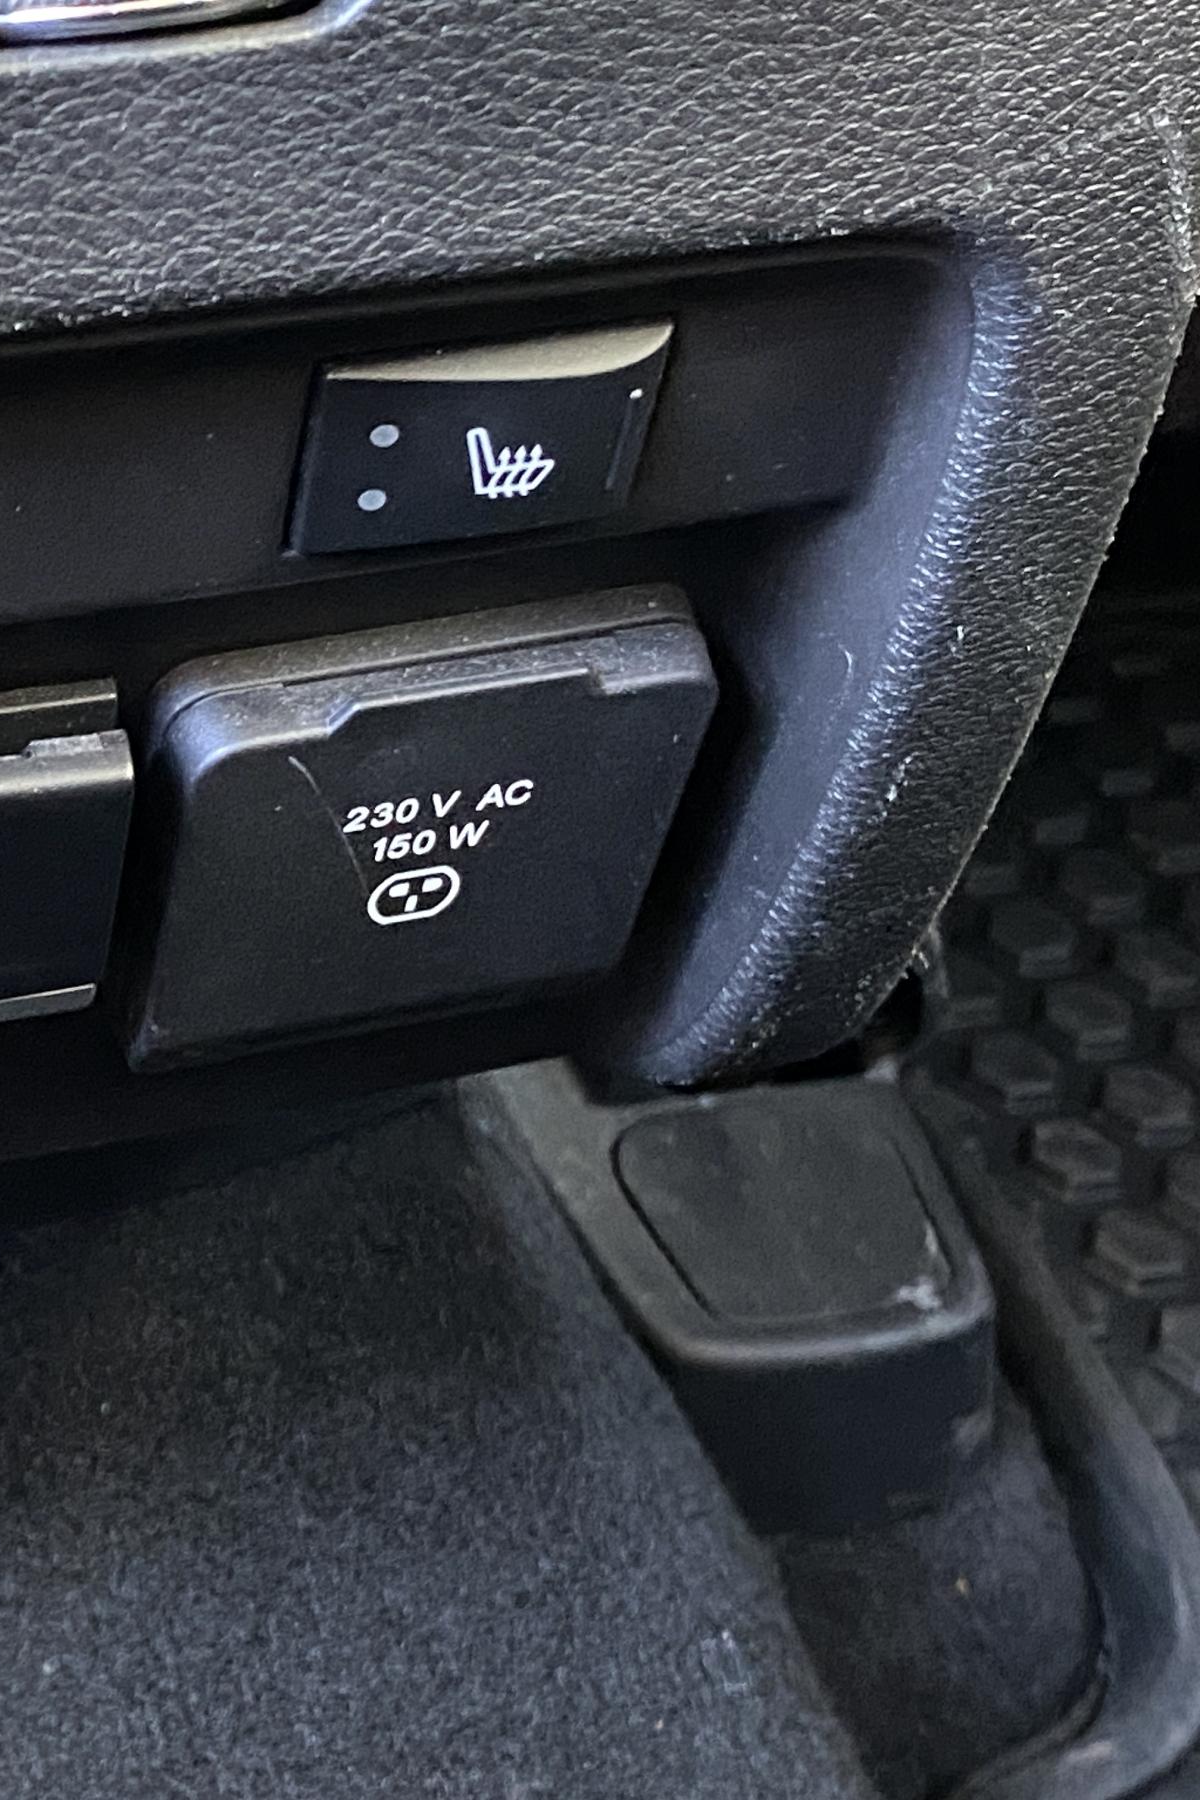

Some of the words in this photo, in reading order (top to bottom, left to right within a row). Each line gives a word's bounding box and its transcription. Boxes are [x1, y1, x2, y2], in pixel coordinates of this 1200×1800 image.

[342, 797, 420, 834] 230
[432, 789, 462, 818] V
[475, 778, 534, 812] AC
[373, 829, 437, 863] 150
[449, 819, 490, 850] W
